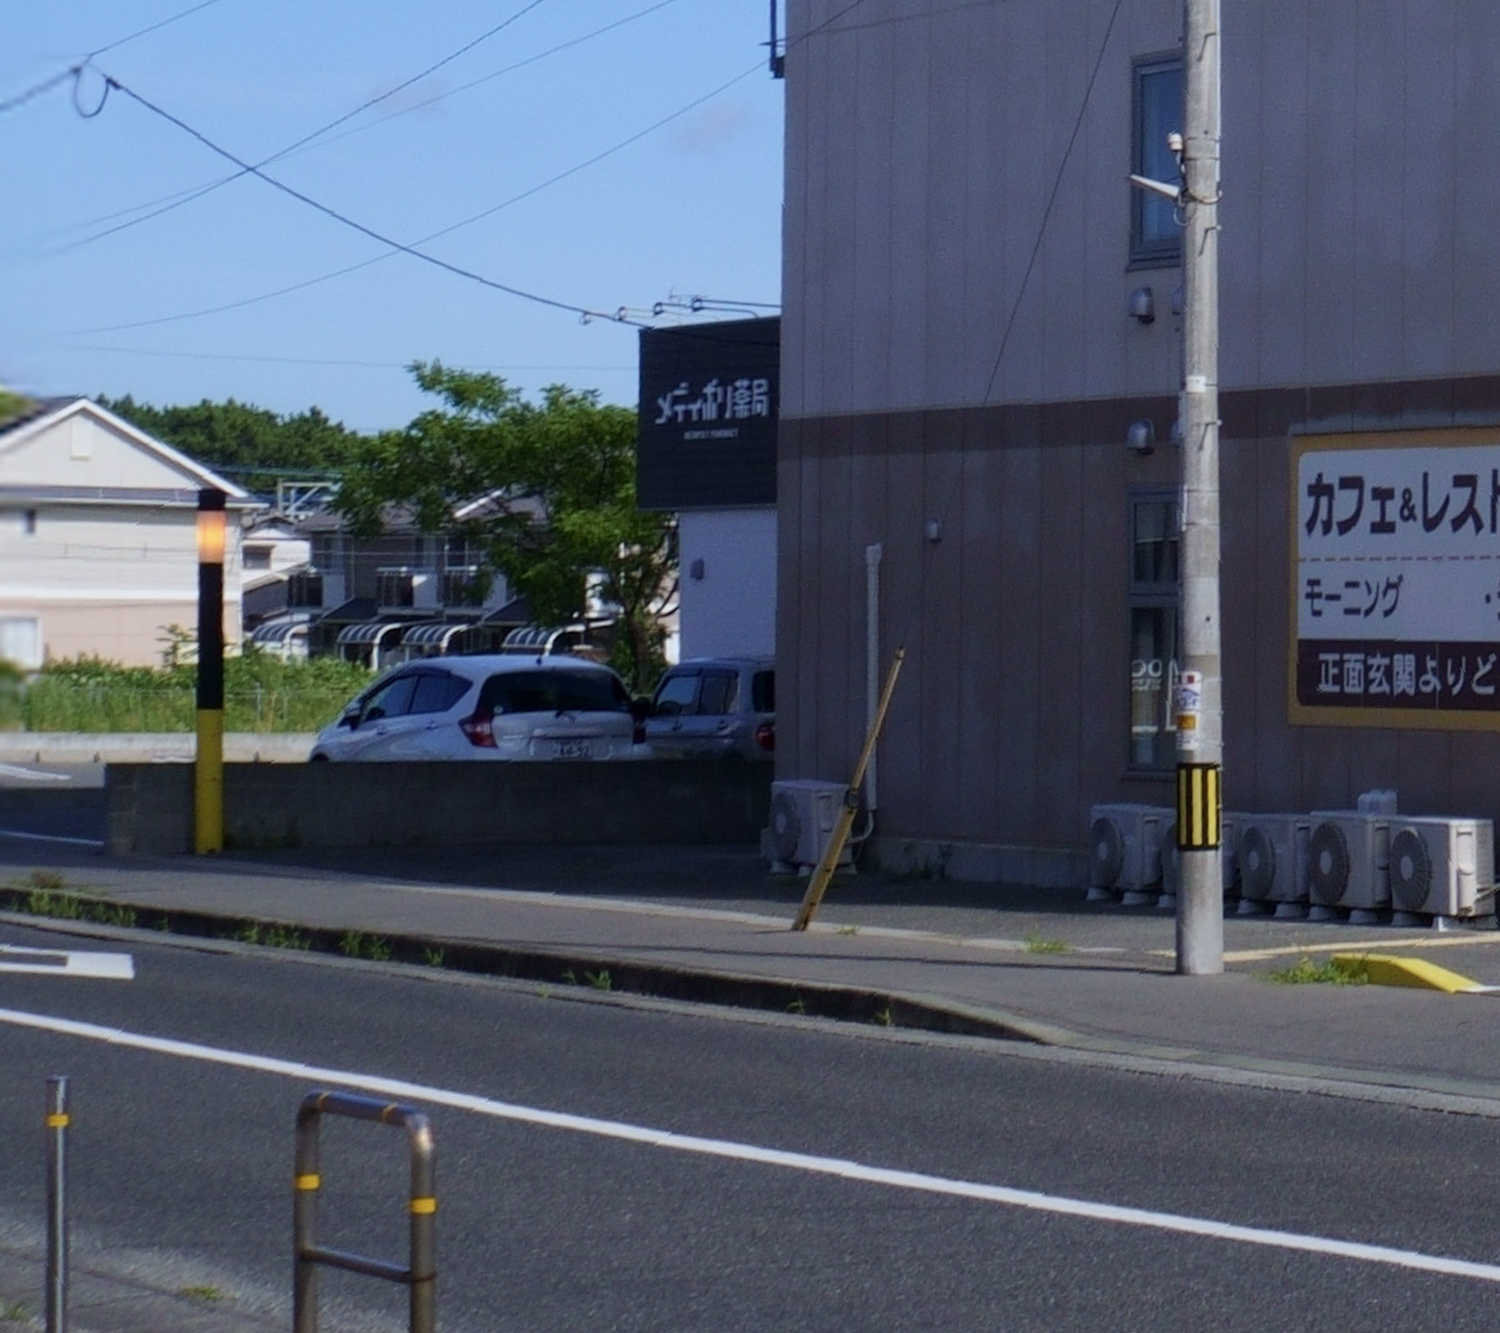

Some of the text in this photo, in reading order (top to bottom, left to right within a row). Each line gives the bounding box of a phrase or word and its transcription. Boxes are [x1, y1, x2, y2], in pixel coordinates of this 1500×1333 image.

[655, 378, 770, 425] メディポリ薬局
[1304, 574, 1404, 620] モーニング
